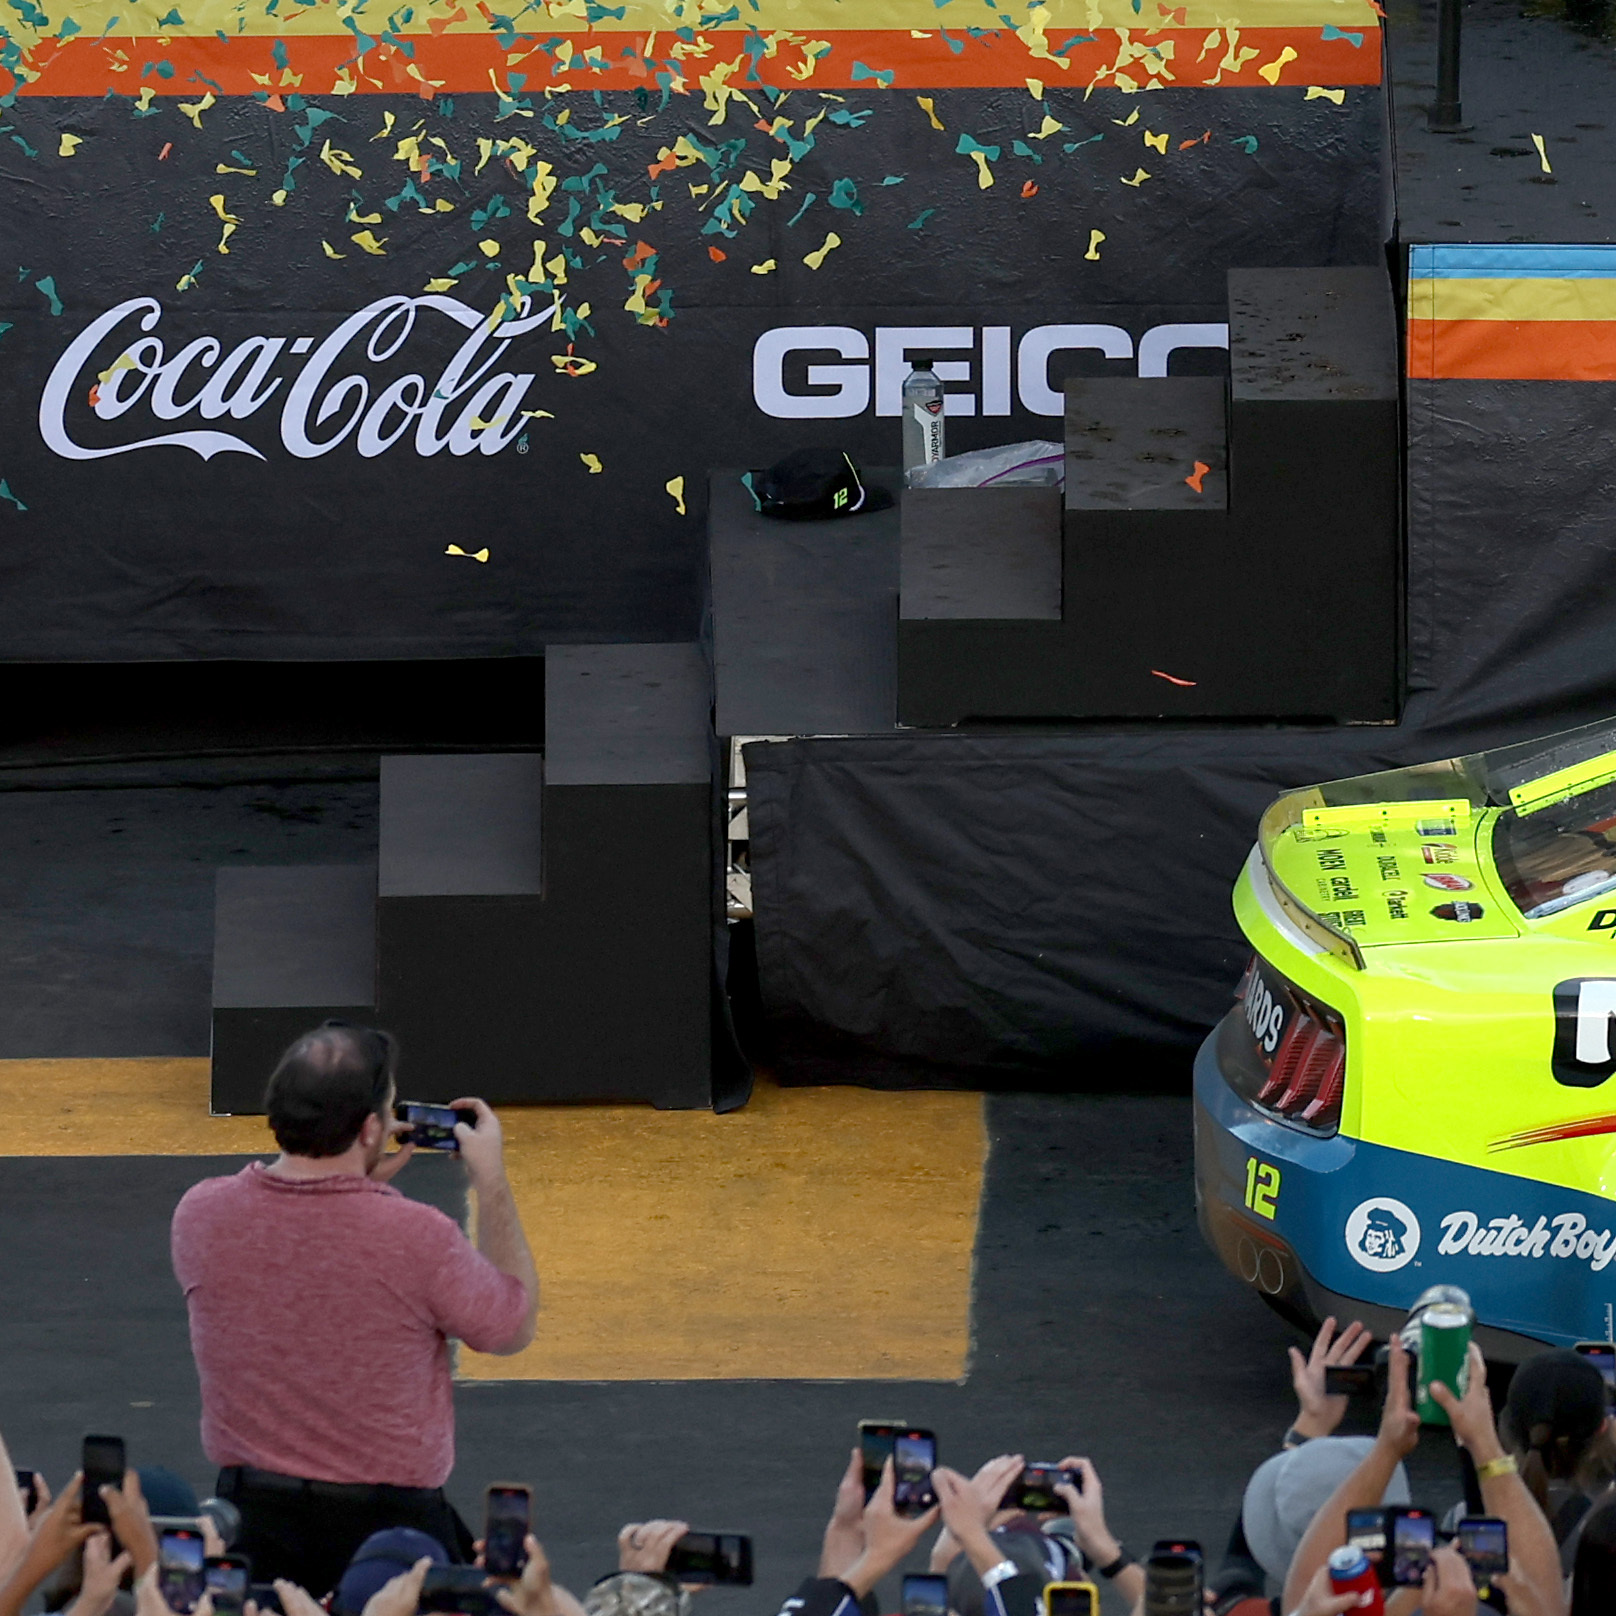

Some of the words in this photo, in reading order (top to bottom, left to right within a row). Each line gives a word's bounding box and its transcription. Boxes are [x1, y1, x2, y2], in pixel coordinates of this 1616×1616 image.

[38, 295, 572, 462] Coca-Cola
[832, 487, 849, 510] 12
[1243, 1156, 1283, 1221] 12
